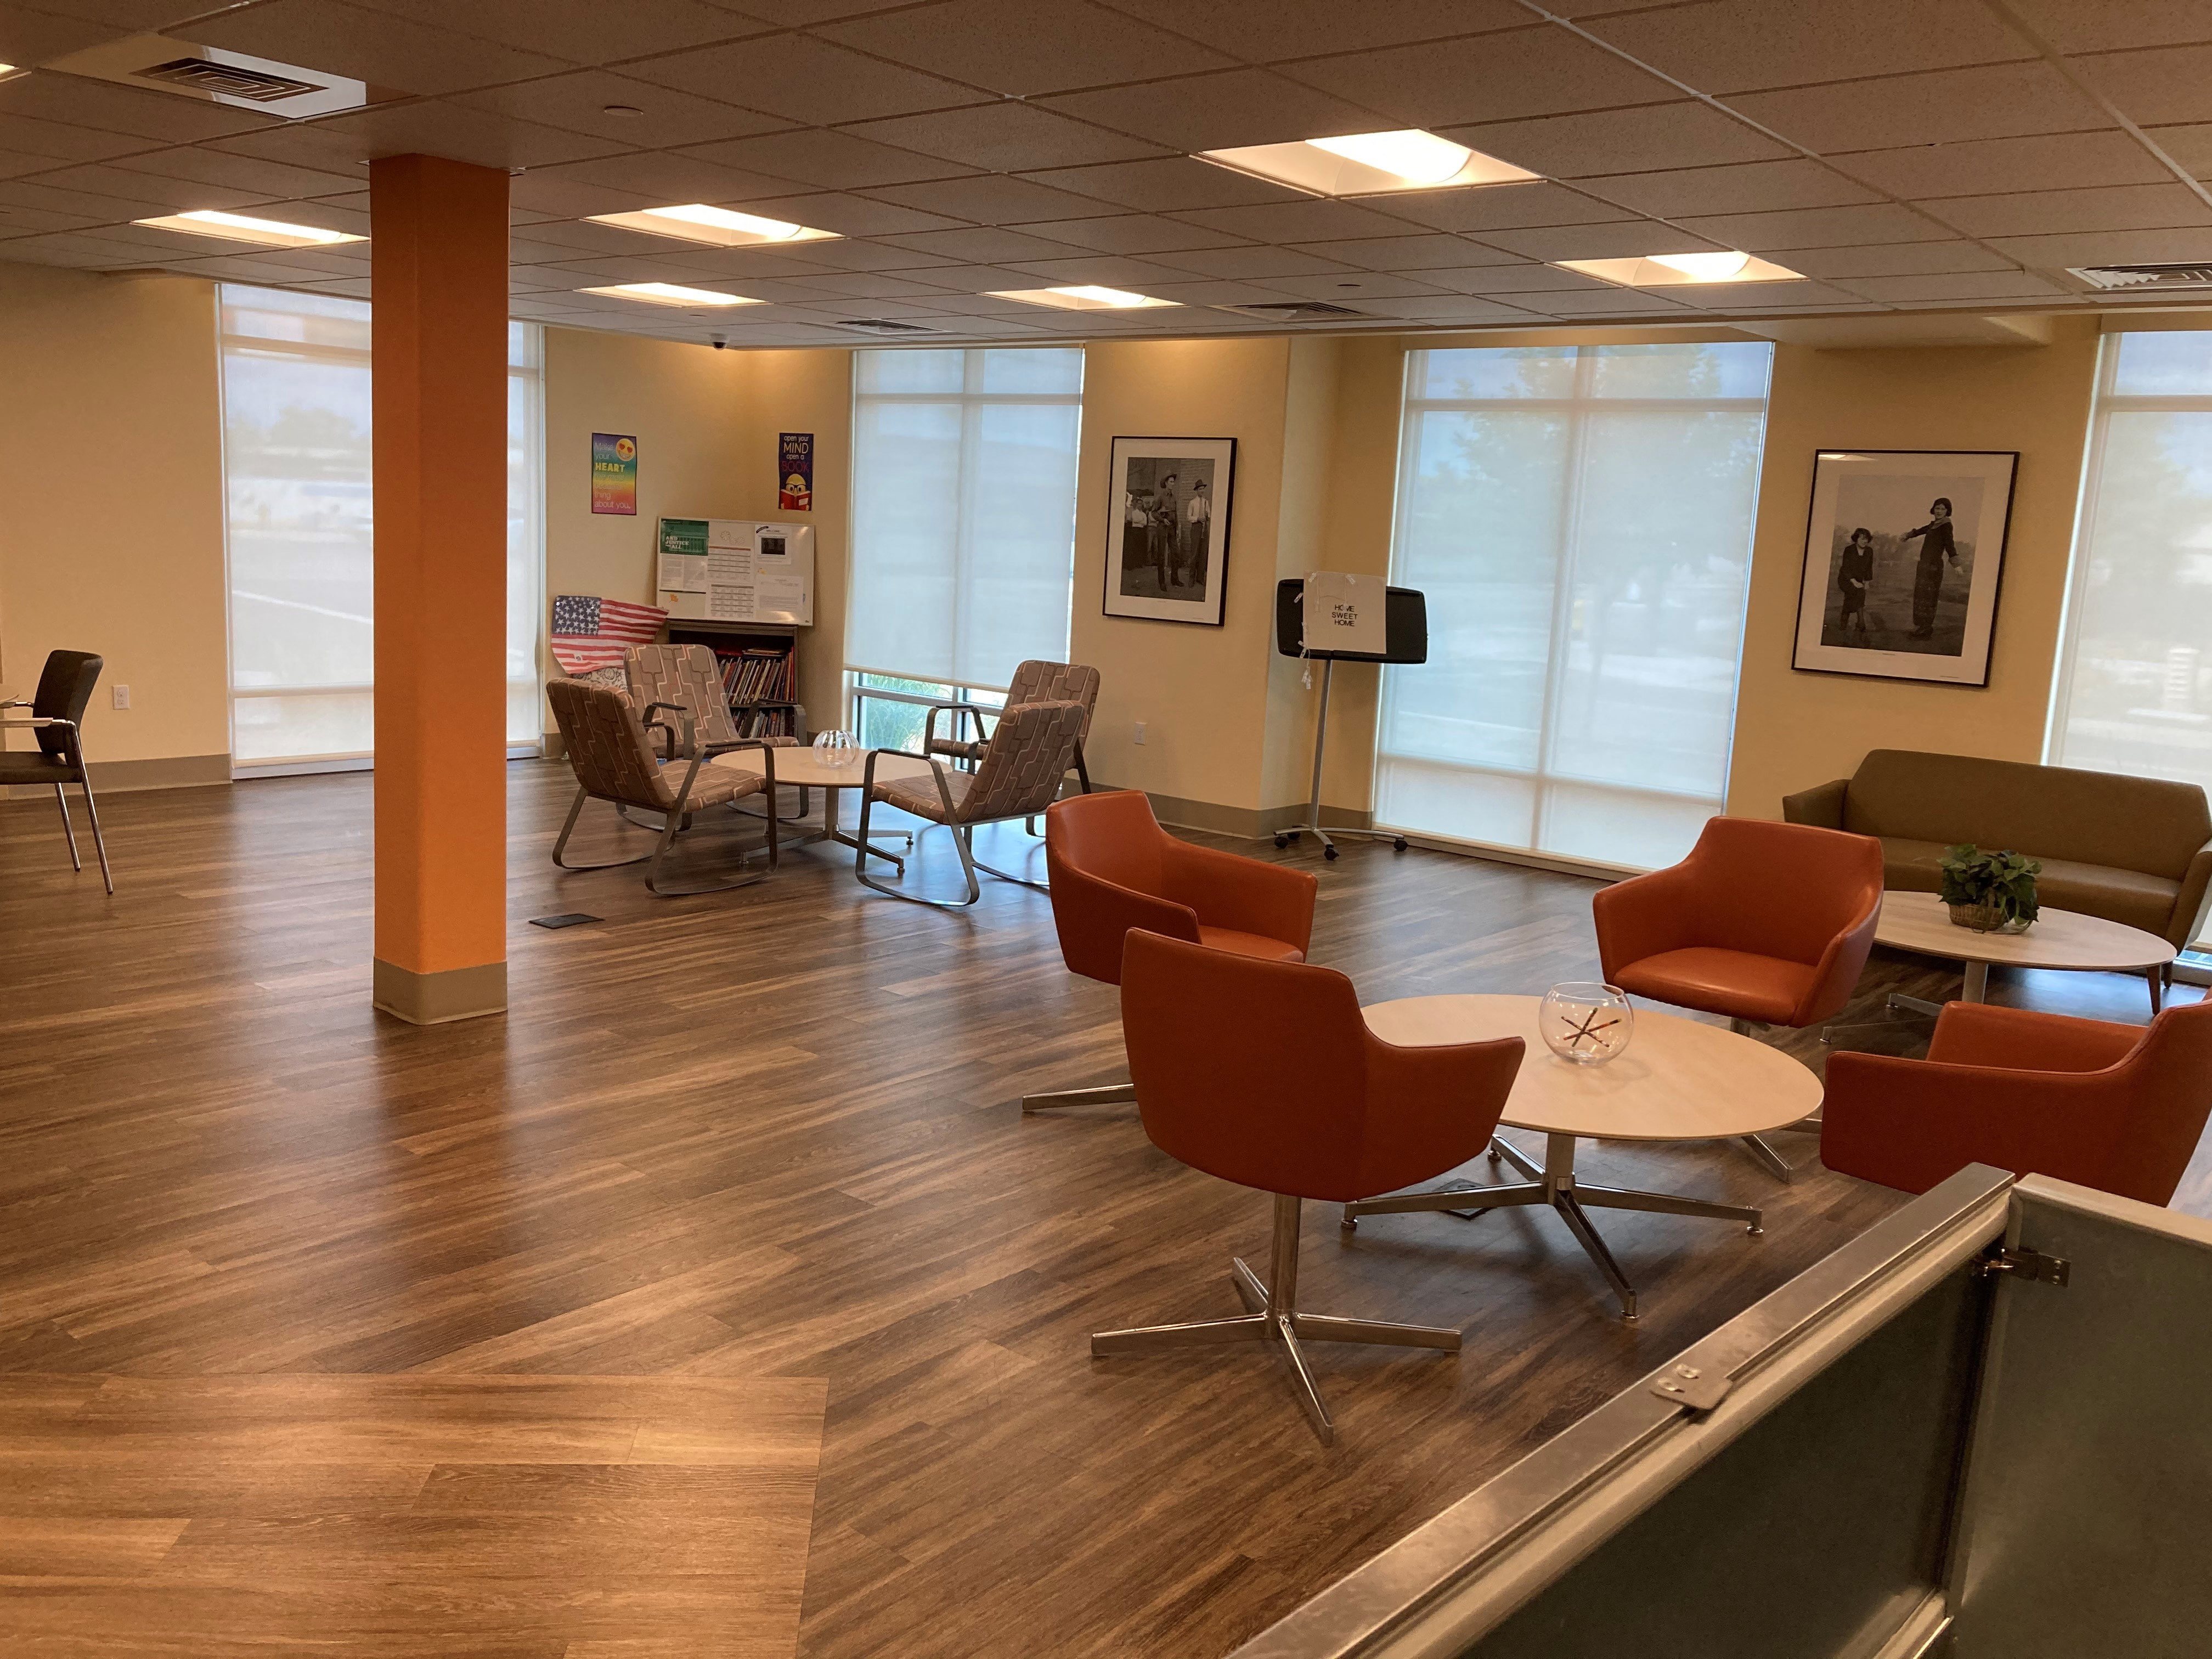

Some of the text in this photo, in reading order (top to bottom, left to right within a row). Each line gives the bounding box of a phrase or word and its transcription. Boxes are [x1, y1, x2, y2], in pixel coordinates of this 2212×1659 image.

[595, 442, 613, 451] Make
[783, 442, 809, 454] MIND
[595, 462, 625, 472] HEART
[594, 491, 611, 500] thing
[616, 501, 631, 510] you.
[1331, 612, 1358, 620] SWEET
